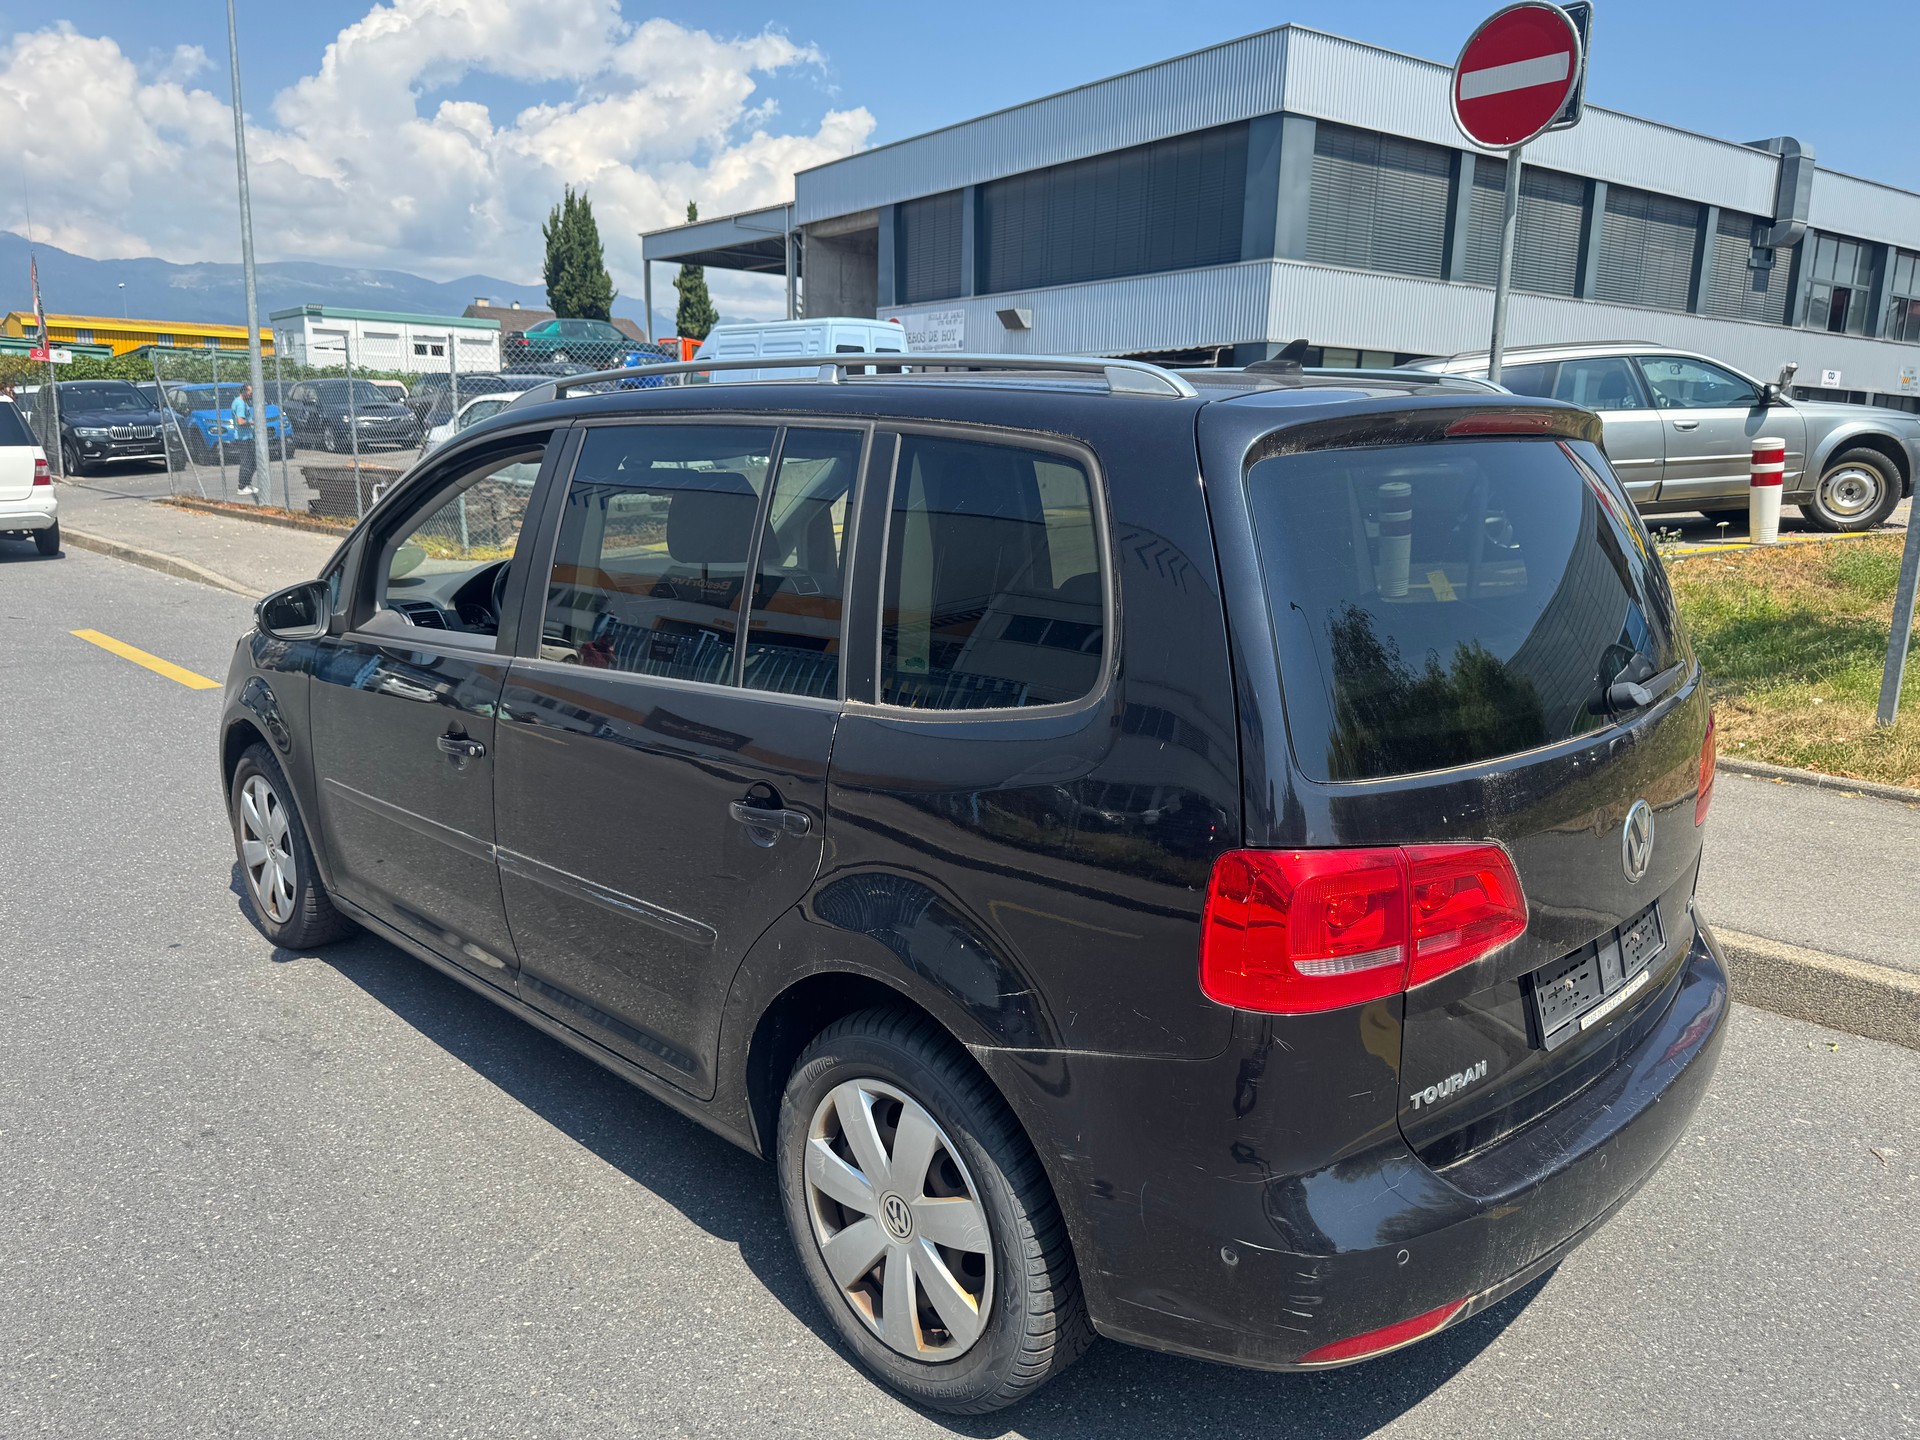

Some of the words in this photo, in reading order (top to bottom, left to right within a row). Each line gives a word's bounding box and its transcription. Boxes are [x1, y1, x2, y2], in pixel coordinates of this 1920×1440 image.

[929, 330, 939, 342] DE
[941, 329, 957, 342] HOY
[1410, 1060, 1487, 1110] TOURAN
